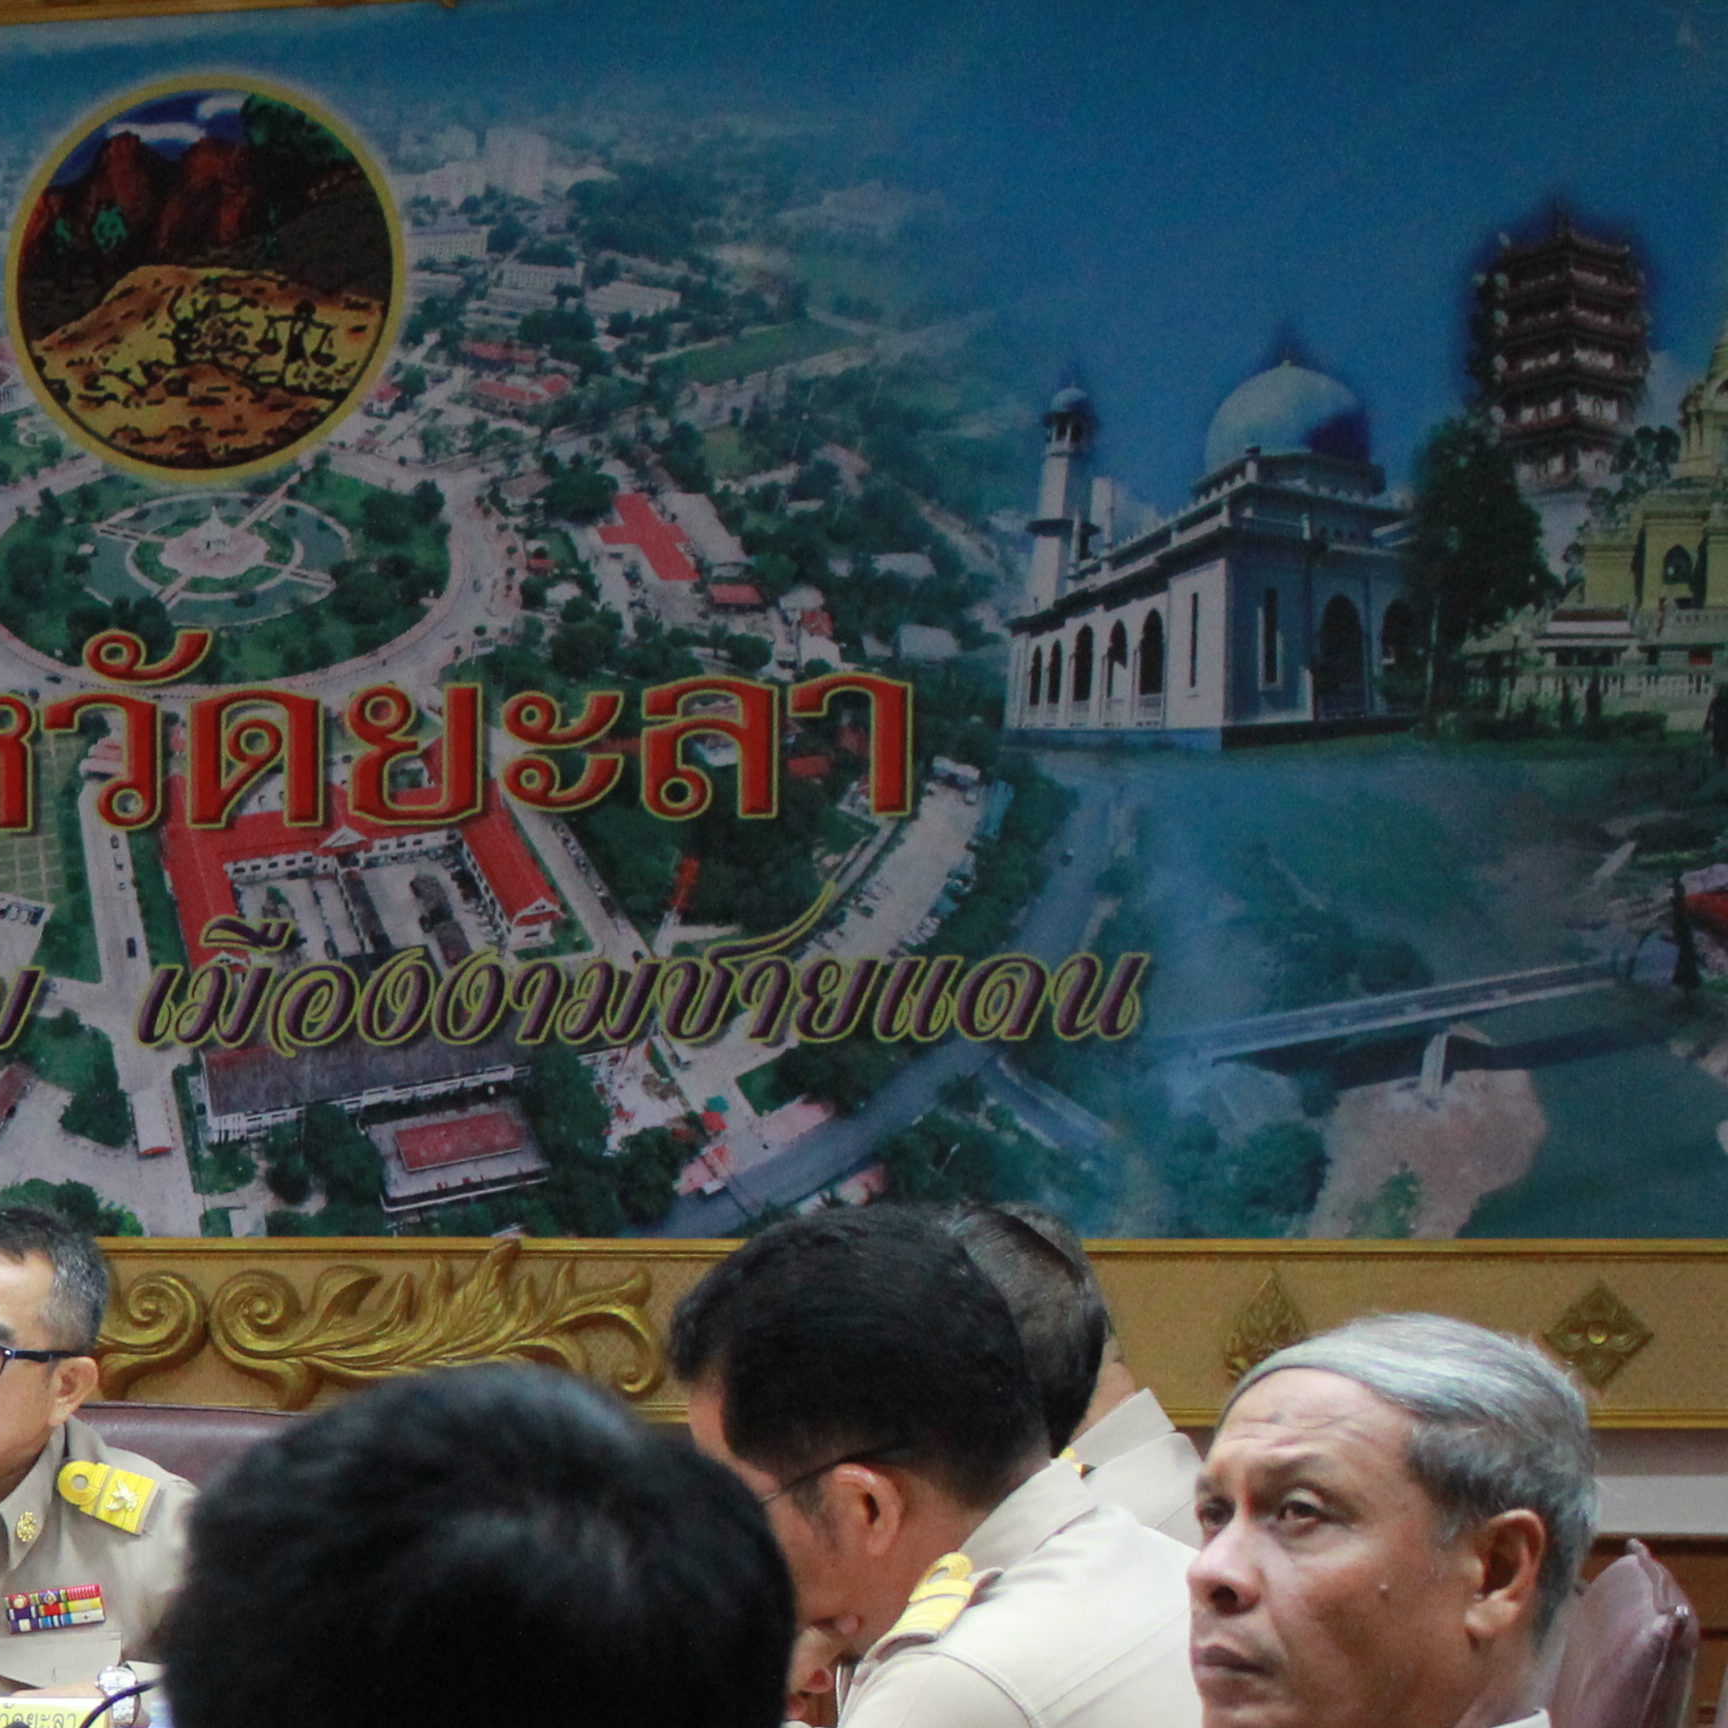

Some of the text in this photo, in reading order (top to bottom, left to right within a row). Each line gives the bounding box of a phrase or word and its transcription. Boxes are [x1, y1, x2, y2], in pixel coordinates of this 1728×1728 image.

[134, 880, 1150, 1057] เมืองงามชายแดน
